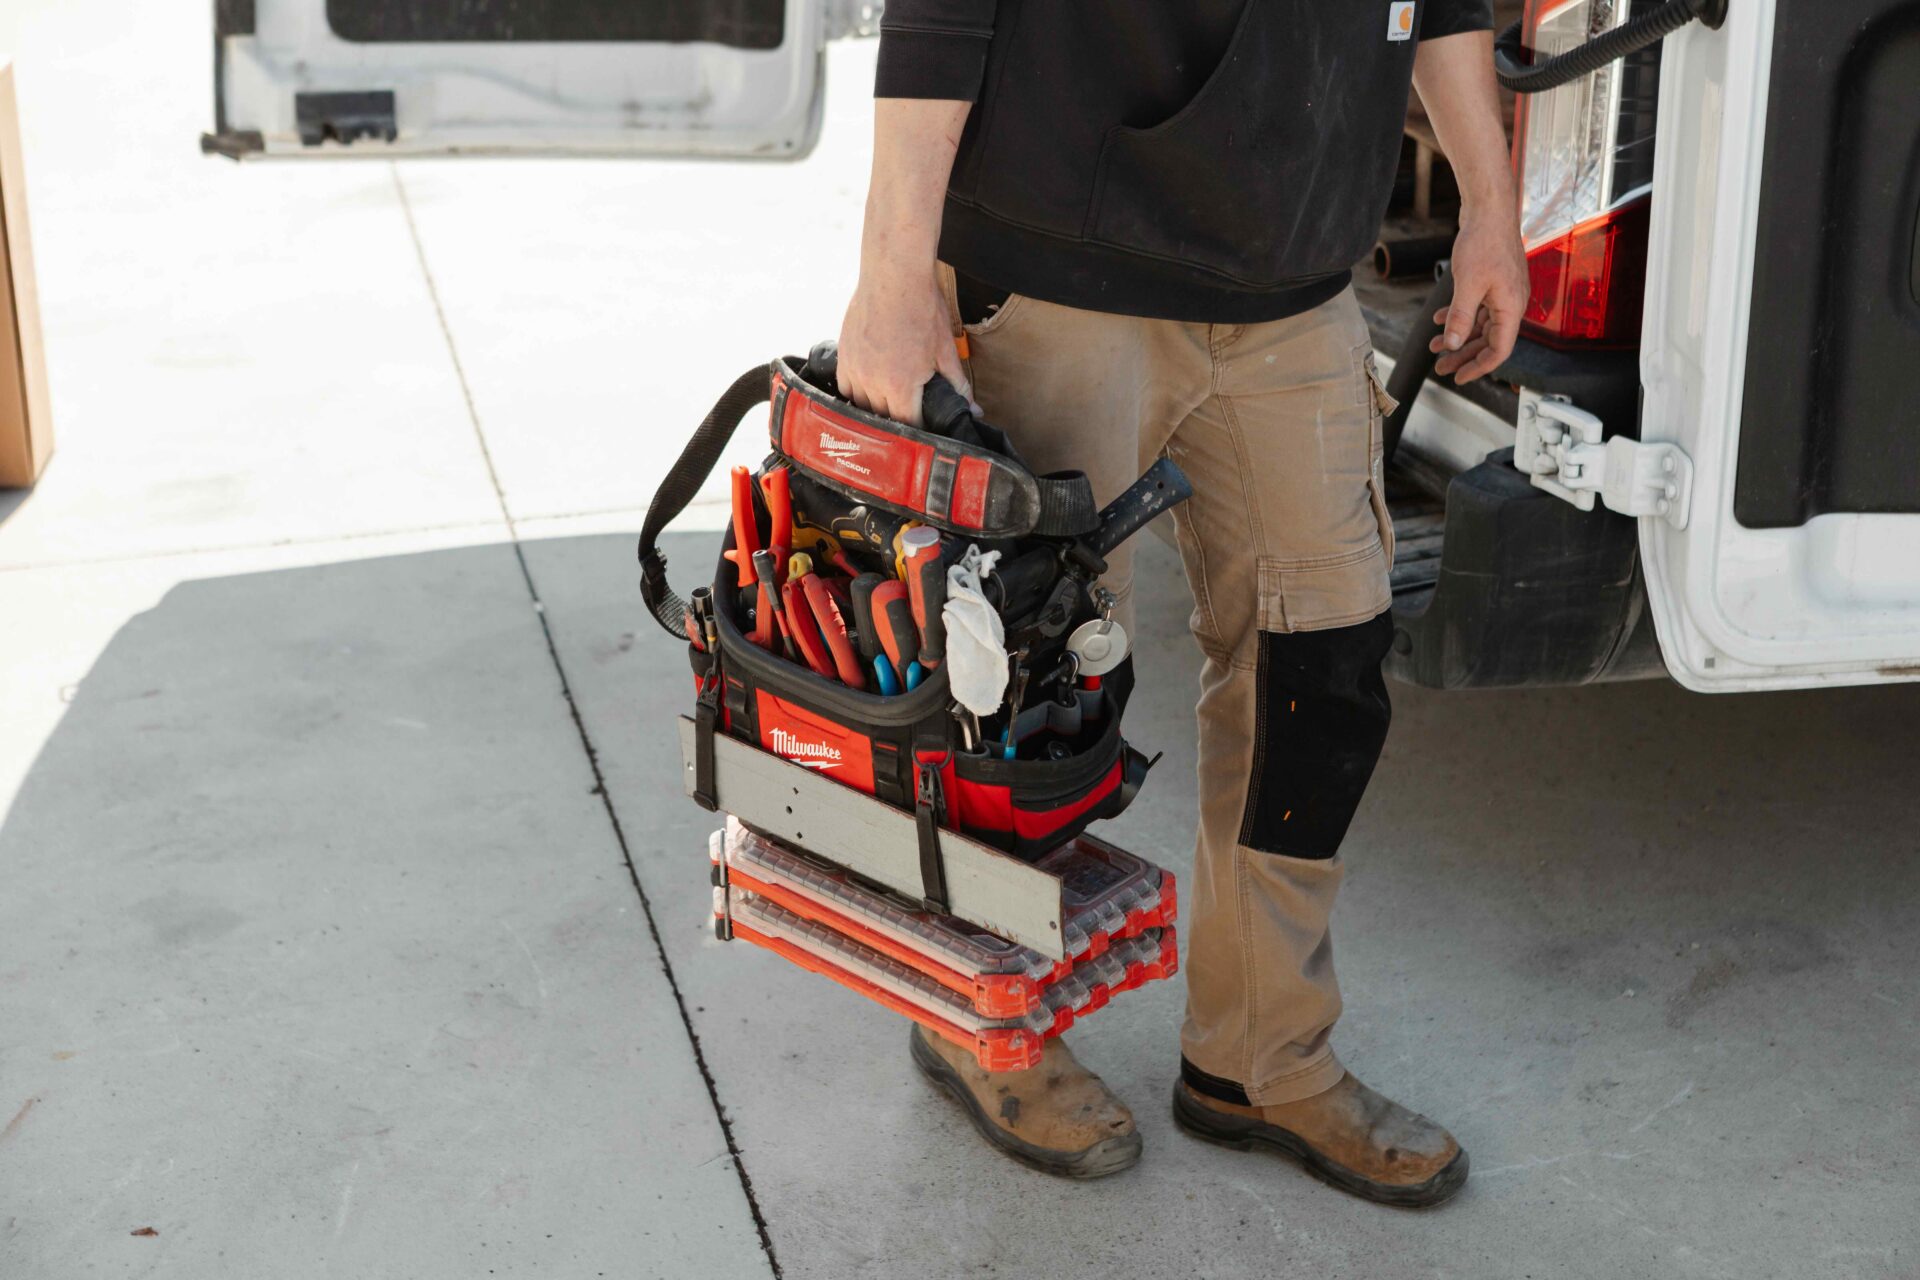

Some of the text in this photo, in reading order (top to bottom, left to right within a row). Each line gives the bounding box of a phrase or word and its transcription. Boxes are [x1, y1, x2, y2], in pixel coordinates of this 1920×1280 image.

[820, 432, 860, 450] Milwaukee
[837, 458, 871, 475] PACKOUT
[769, 728, 842, 760] Milwaukee
